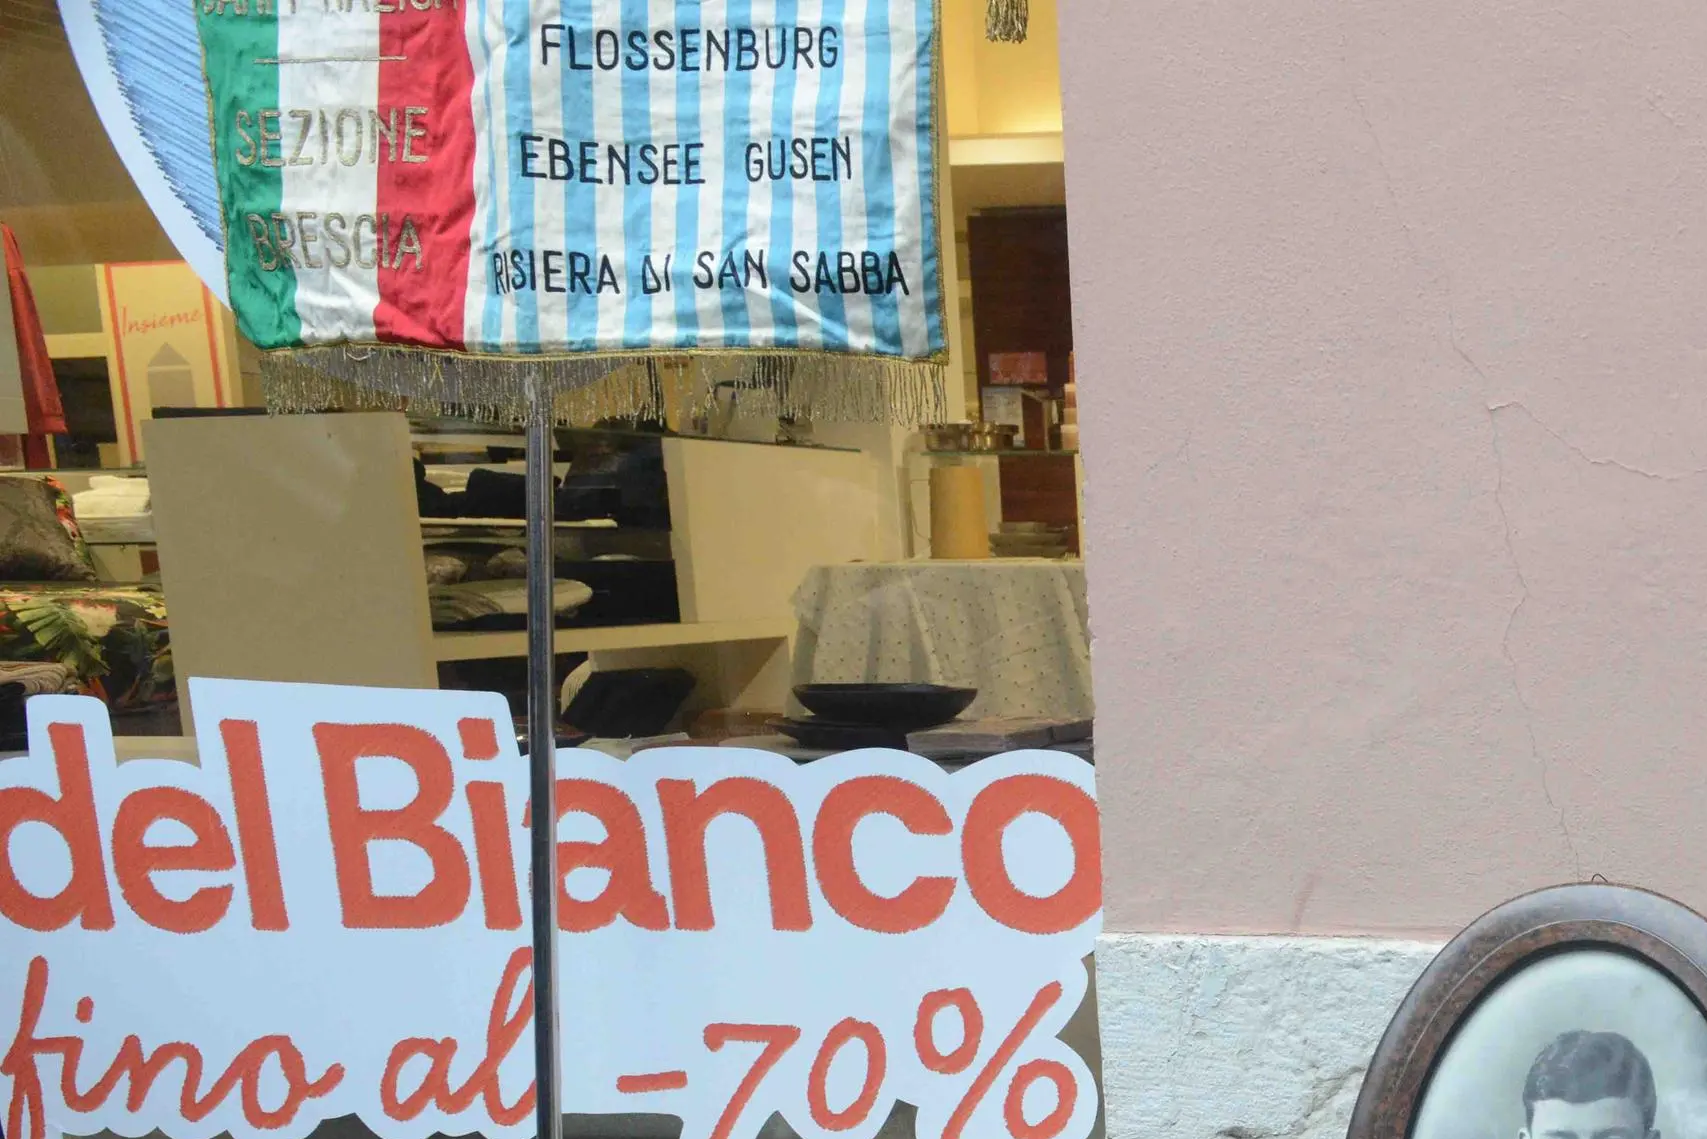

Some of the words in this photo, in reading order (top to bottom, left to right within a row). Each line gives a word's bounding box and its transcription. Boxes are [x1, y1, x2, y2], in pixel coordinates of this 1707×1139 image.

[540, 24, 839, 72] FLOSSENBURG
[234, 106, 429, 167] SEZIONE
[519, 134, 706, 186] EBENSEE
[744, 136, 852, 182] GUSEN
[247, 211, 423, 272] BRESCIA
[492, 249, 621, 296] RISIERA
[641, 254, 671, 296] DI
[692, 250, 768, 290] SAN
[789, 250, 911, 297] SABBA
[0, 719, 289, 934] del
[312, 717, 1103, 935] Bianco
[380, 946, 537, 1126] al
